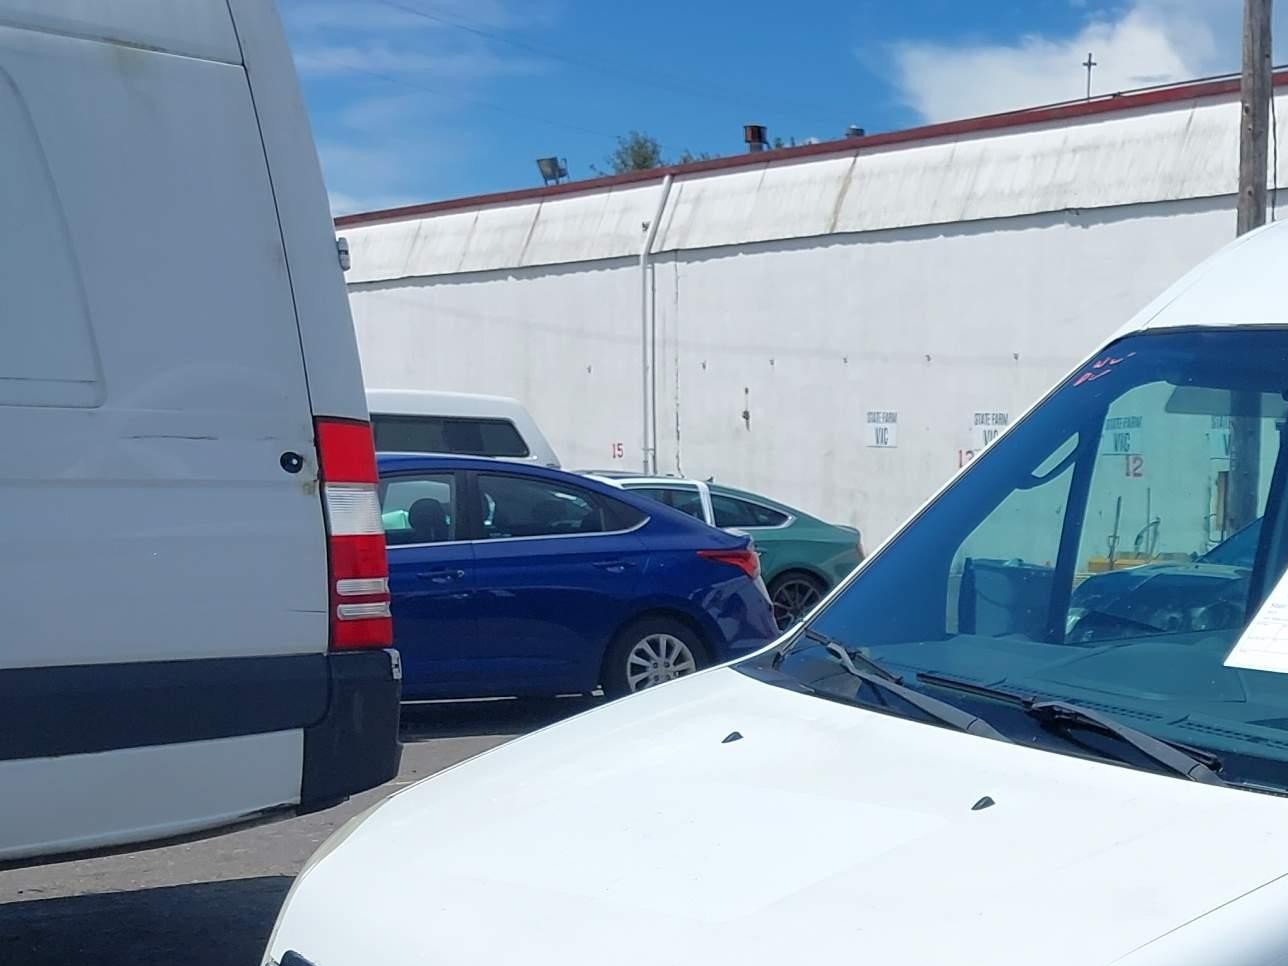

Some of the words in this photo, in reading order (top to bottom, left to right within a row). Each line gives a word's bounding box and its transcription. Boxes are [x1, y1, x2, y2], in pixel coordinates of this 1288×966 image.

[867, 412, 882, 424] STATE
[882, 412, 898, 424] FARM
[974, 412, 991, 426] STATE
[992, 412, 1009, 426] FARM
[1123, 416, 1143, 429] FARM
[875, 427, 889, 445] VIC
[1113, 432, 1130, 452] VIC
[612, 442, 624, 459] 15
[1125, 455, 1144, 477] 12
